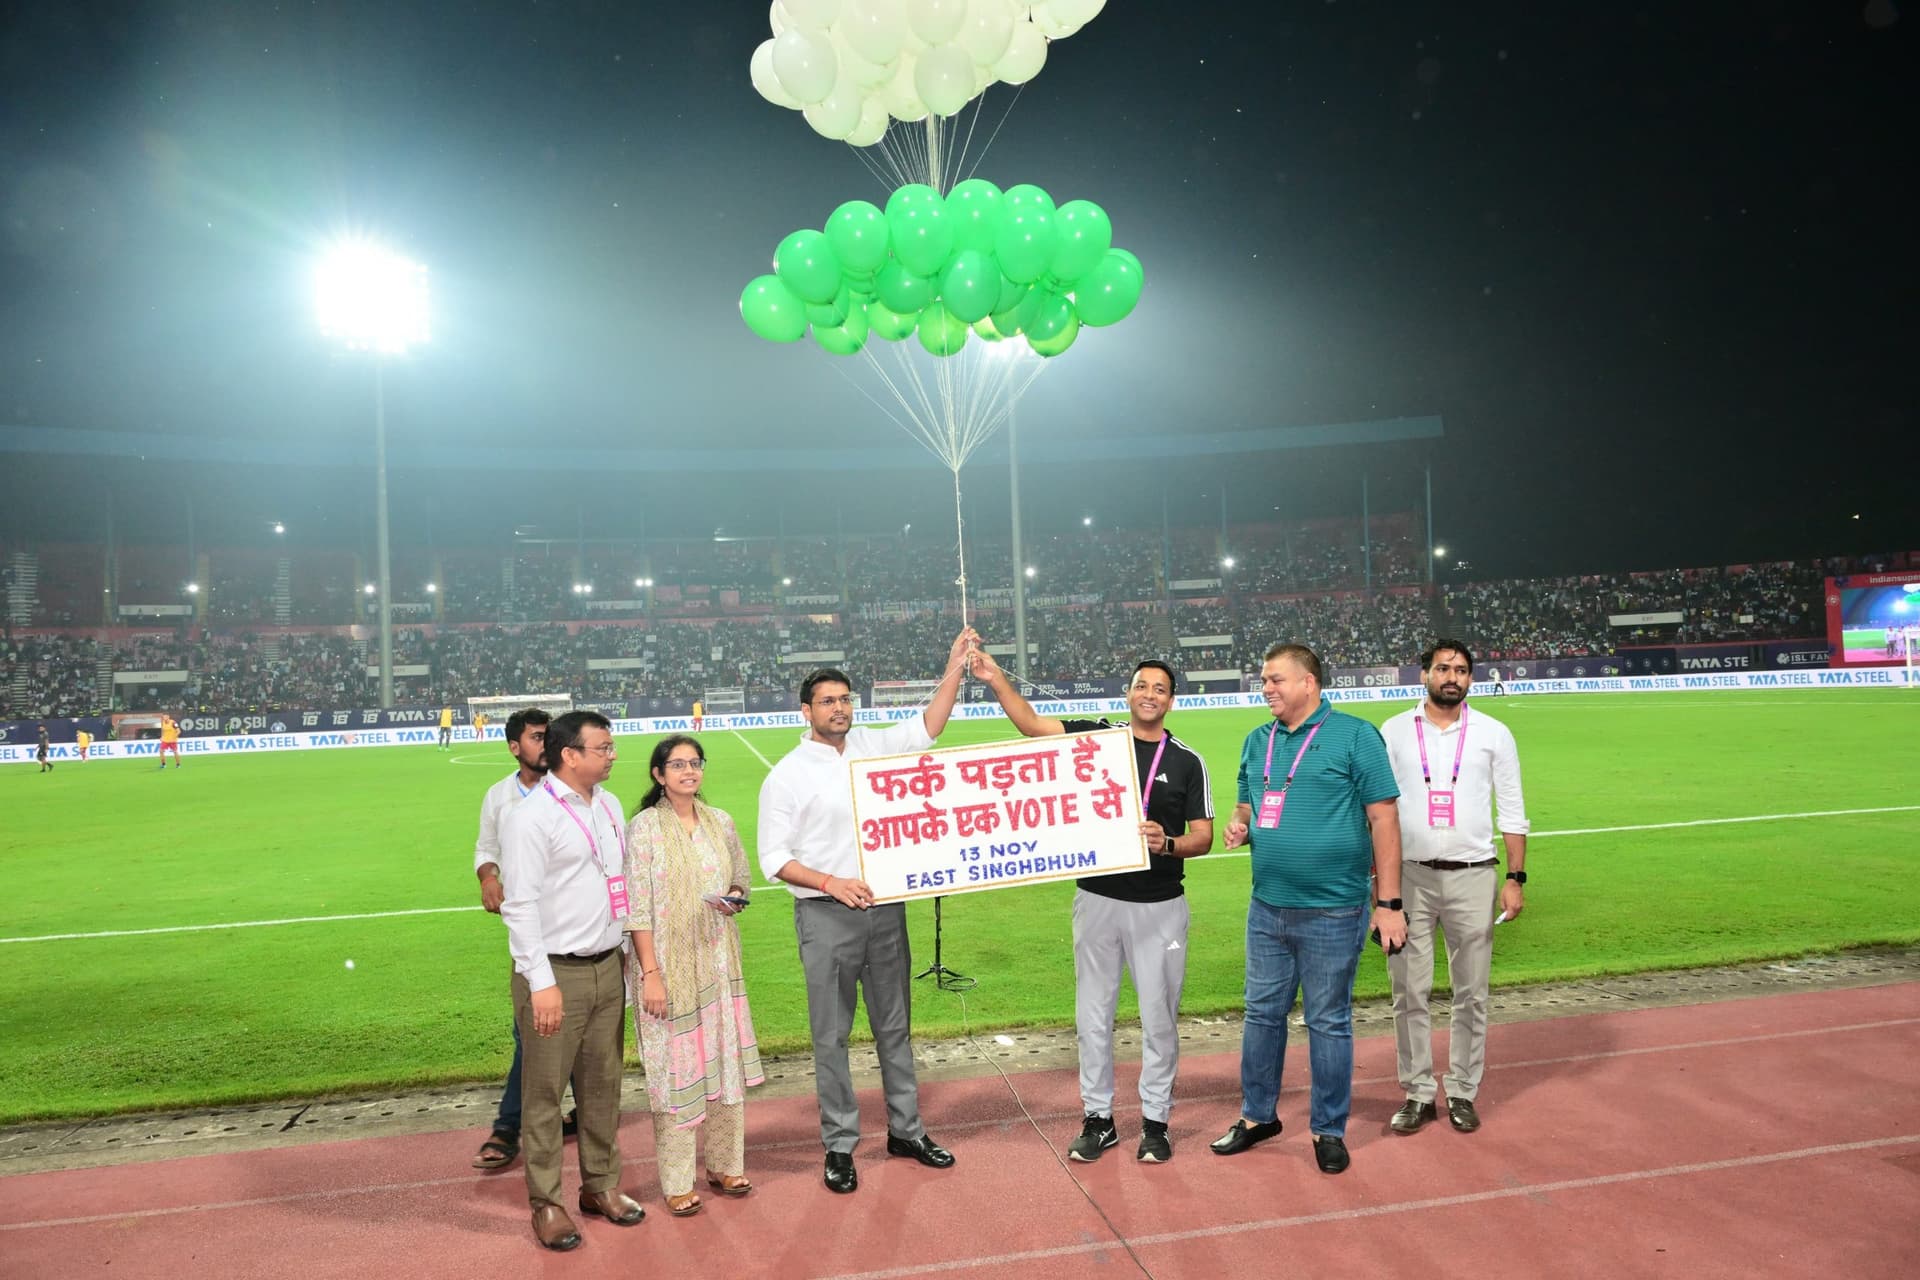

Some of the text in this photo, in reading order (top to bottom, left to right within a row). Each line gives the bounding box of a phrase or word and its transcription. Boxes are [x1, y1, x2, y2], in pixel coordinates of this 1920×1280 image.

[1680, 657, 1721, 669] TATA
[1337, 675, 1356, 687] SBI
[1376, 674, 1396, 685] SBI
[1629, 678, 1681, 688] TATA STEEL
[1683, 675, 1741, 687] TATA STEEL
[1747, 673, 1813, 685] TATA STEEL
[1818, 671, 1893, 683] TATA STEEL
[1538, 681, 1571, 690] STEEL
[1576, 679, 1624, 689] TATA STEEL
[1344, 690, 1374, 699] STEEL
[1380, 687, 1428, 698] TATA STE
[1177, 695, 1240, 707] TATA STEEL
[963, 706, 996, 716] TATA
[1035, 702, 1101, 713] TATA STEEL
[243, 716, 267, 729] SBI
[387, 711, 425, 722] TATA
[731, 714, 800, 726] TATA STEEL
[855, 711, 881, 722] TEEL
[195, 717, 219, 730] SBI
[653, 717, 726, 730] TATA SEEL
[309, 733, 391, 746] TATA STEEL
[396, 731, 435, 742] TATA
[178, 741, 210, 753] TEEL
[216, 736, 299, 750] TATA STEEL
[26, 745, 114, 758] TTA SEEL
[866, 754, 946, 801] फर्क
[956, 749, 1060, 797] पड़ता
[862, 778, 1127, 852] आपके एक VOTE से
[959, 840, 1038, 862] 13 NOV
[906, 850, 1097, 890] EAST SINGHBHUM
